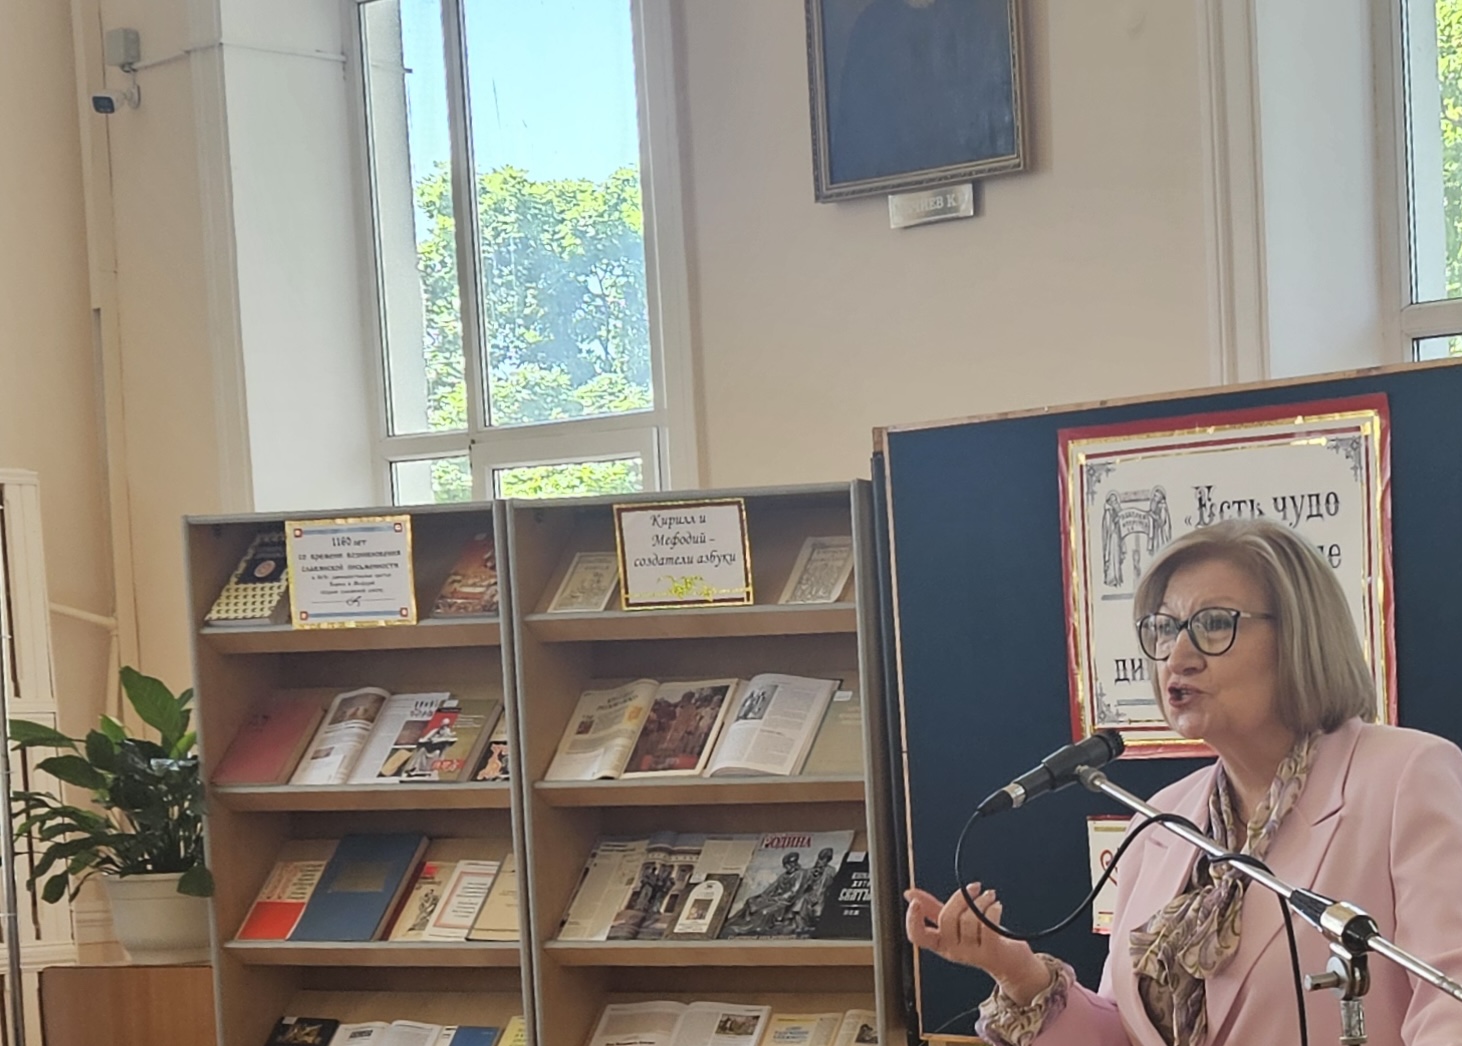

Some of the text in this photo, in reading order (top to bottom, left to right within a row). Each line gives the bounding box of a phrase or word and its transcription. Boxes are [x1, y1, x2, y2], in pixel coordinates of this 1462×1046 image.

[1272, 491, 1341, 529] чудо
[650, 513, 707, 530] Кирилл и
[651, 531, 706, 550] Мефодий
[633, 549, 737, 568] создатели азбуки
